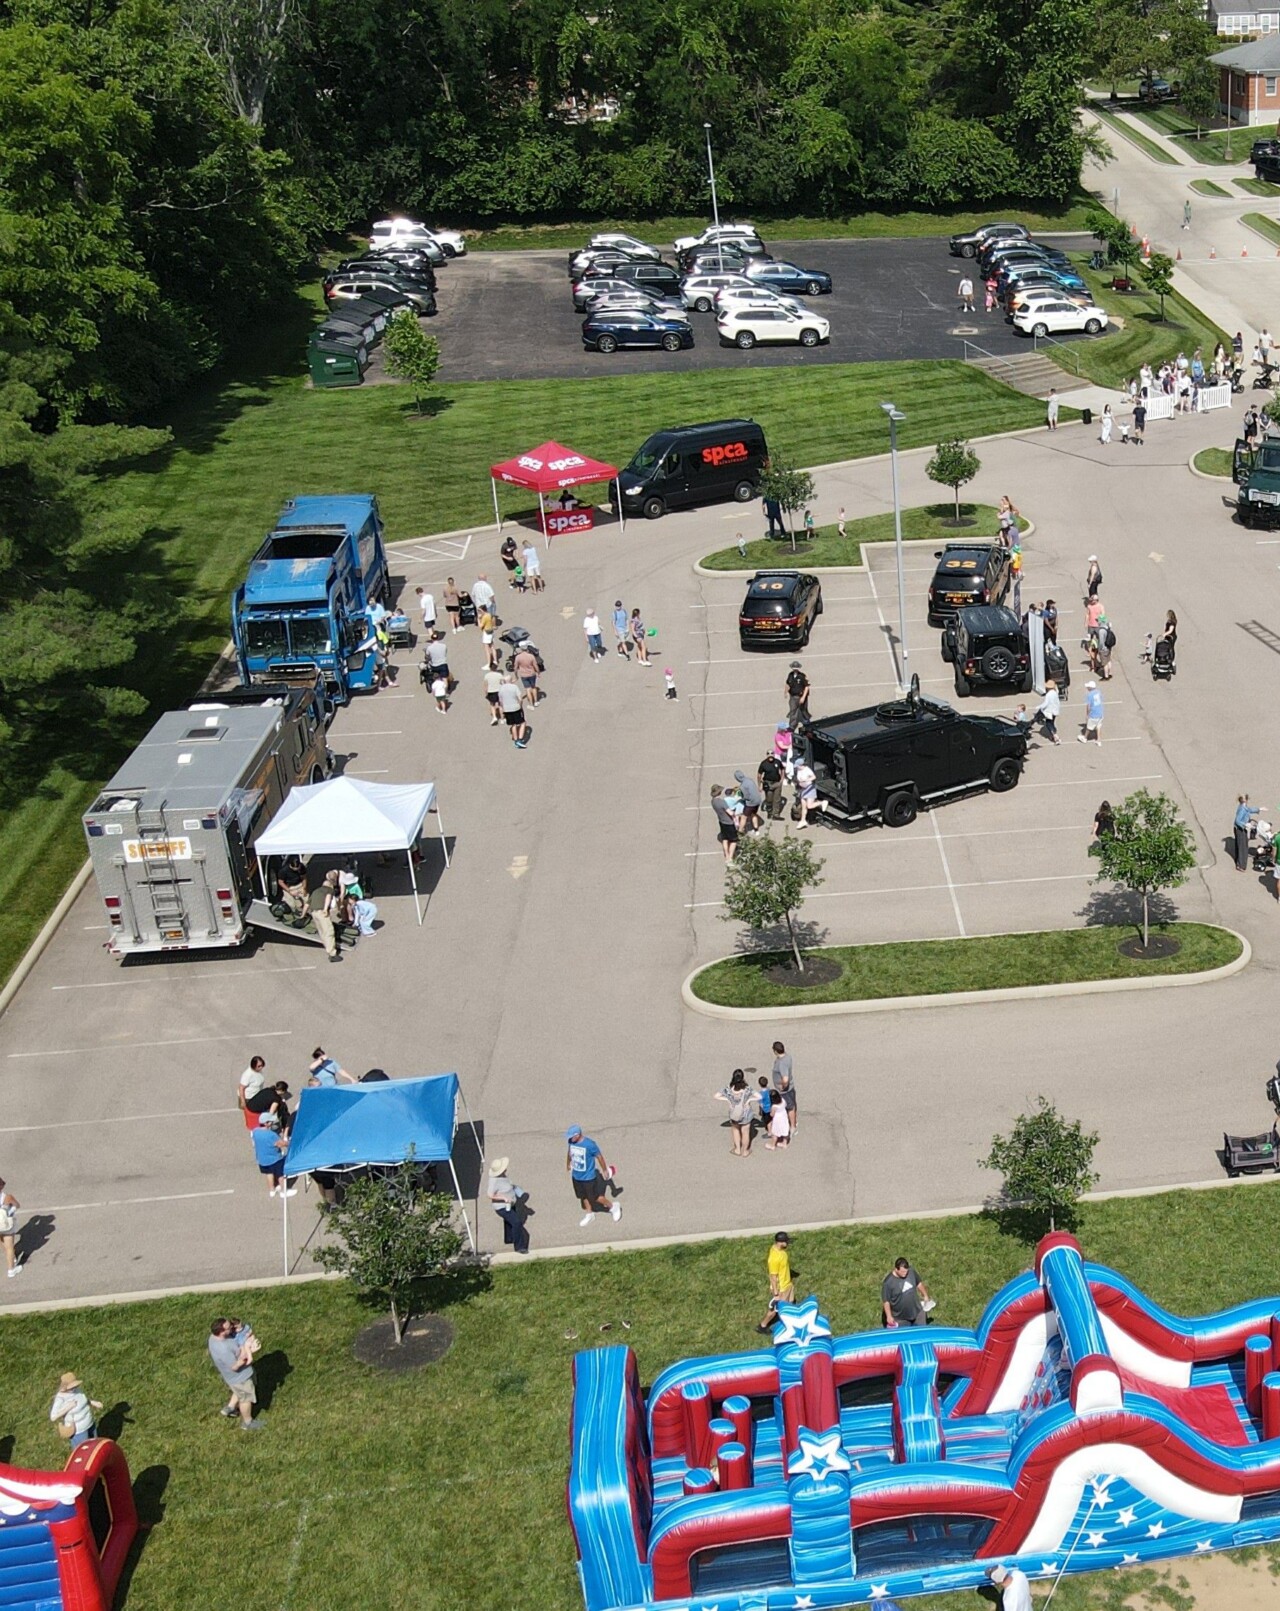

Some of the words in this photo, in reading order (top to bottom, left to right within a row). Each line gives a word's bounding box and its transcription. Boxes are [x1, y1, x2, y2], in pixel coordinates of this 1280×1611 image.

[702, 442, 748, 466] spca
[548, 456, 585, 471] spca
[548, 514, 591, 532] spca
[945, 560, 977, 568] 32
[759, 582, 783, 590] 10
